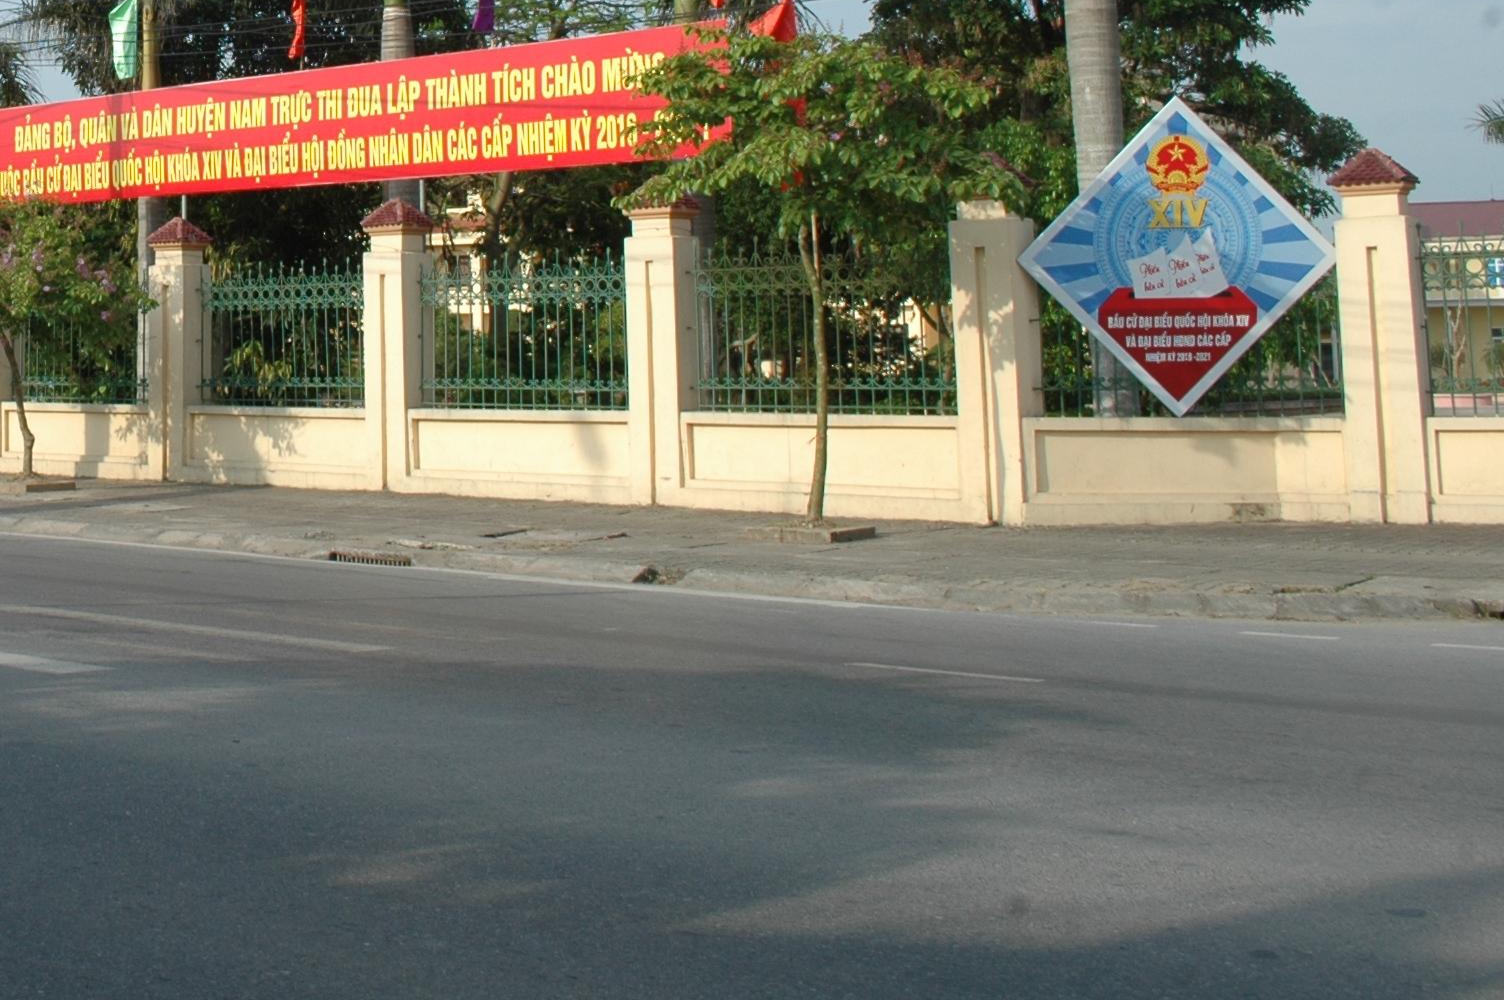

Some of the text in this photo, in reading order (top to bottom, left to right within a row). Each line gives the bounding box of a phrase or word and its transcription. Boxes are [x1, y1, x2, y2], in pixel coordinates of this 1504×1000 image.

[14, 113, 51, 153] ĐẢNG
[53, 114, 77, 153] BỘ,
[79, 110, 117, 148] QUÂN
[121, 106, 139, 141] VÀ
[142, 103, 173, 140] DÂN
[176, 96, 227, 139] HUYỆN
[229, 97, 266, 130] NAM
[270, 89, 312, 130] TRỰC
[316, 88, 343, 122] THI
[346, 84, 383, 119] ĐUA
[386, 75, 421, 121] LẬP
[425, 70, 487, 111] THÀNH
[491, 63, 535, 104] TÍCH
[540, 55, 596, 99] CHÀO
[46, 154, 63, 194] CỬ
[63, 164, 83, 198] ĐẠI
[83, 150, 110, 191] BIỂU
[112, 148, 143, 191] QUỐC
[145, 149, 165, 191] HỘI
[167, 146, 200, 183] KHÓA
[202, 150, 223, 181] XIV
[225, 142, 243, 179] VÀ
[244, 146, 266, 183] ĐẠI
[269, 131, 299, 175] BIỂU
[301, 134, 325, 178] HỘI
[327, 128, 366, 171] ĐỒNG
[368, 127, 409, 168] NHÂN
[412, 124, 444, 164] DÂN
[447, 121, 477, 162] CÁC
[481, 112, 513, 159] CẤP
[516, 112, 568, 162] NHIỆM
[570, 109, 593, 152] KỲ
[596, 112, 638, 150] 2016
[1146, 199, 1209, 229] XIV
[1126, 312, 1138, 329] CỬ
[1138, 315, 1153, 331] ĐẠI
[1154, 311, 1173, 329] BIỂU
[1174, 311, 1196, 329] QUỐC
[1197, 312, 1211, 330] HỘI
[1212, 312, 1235, 327] KHÓA
[1236, 314, 1250, 327] XIV
